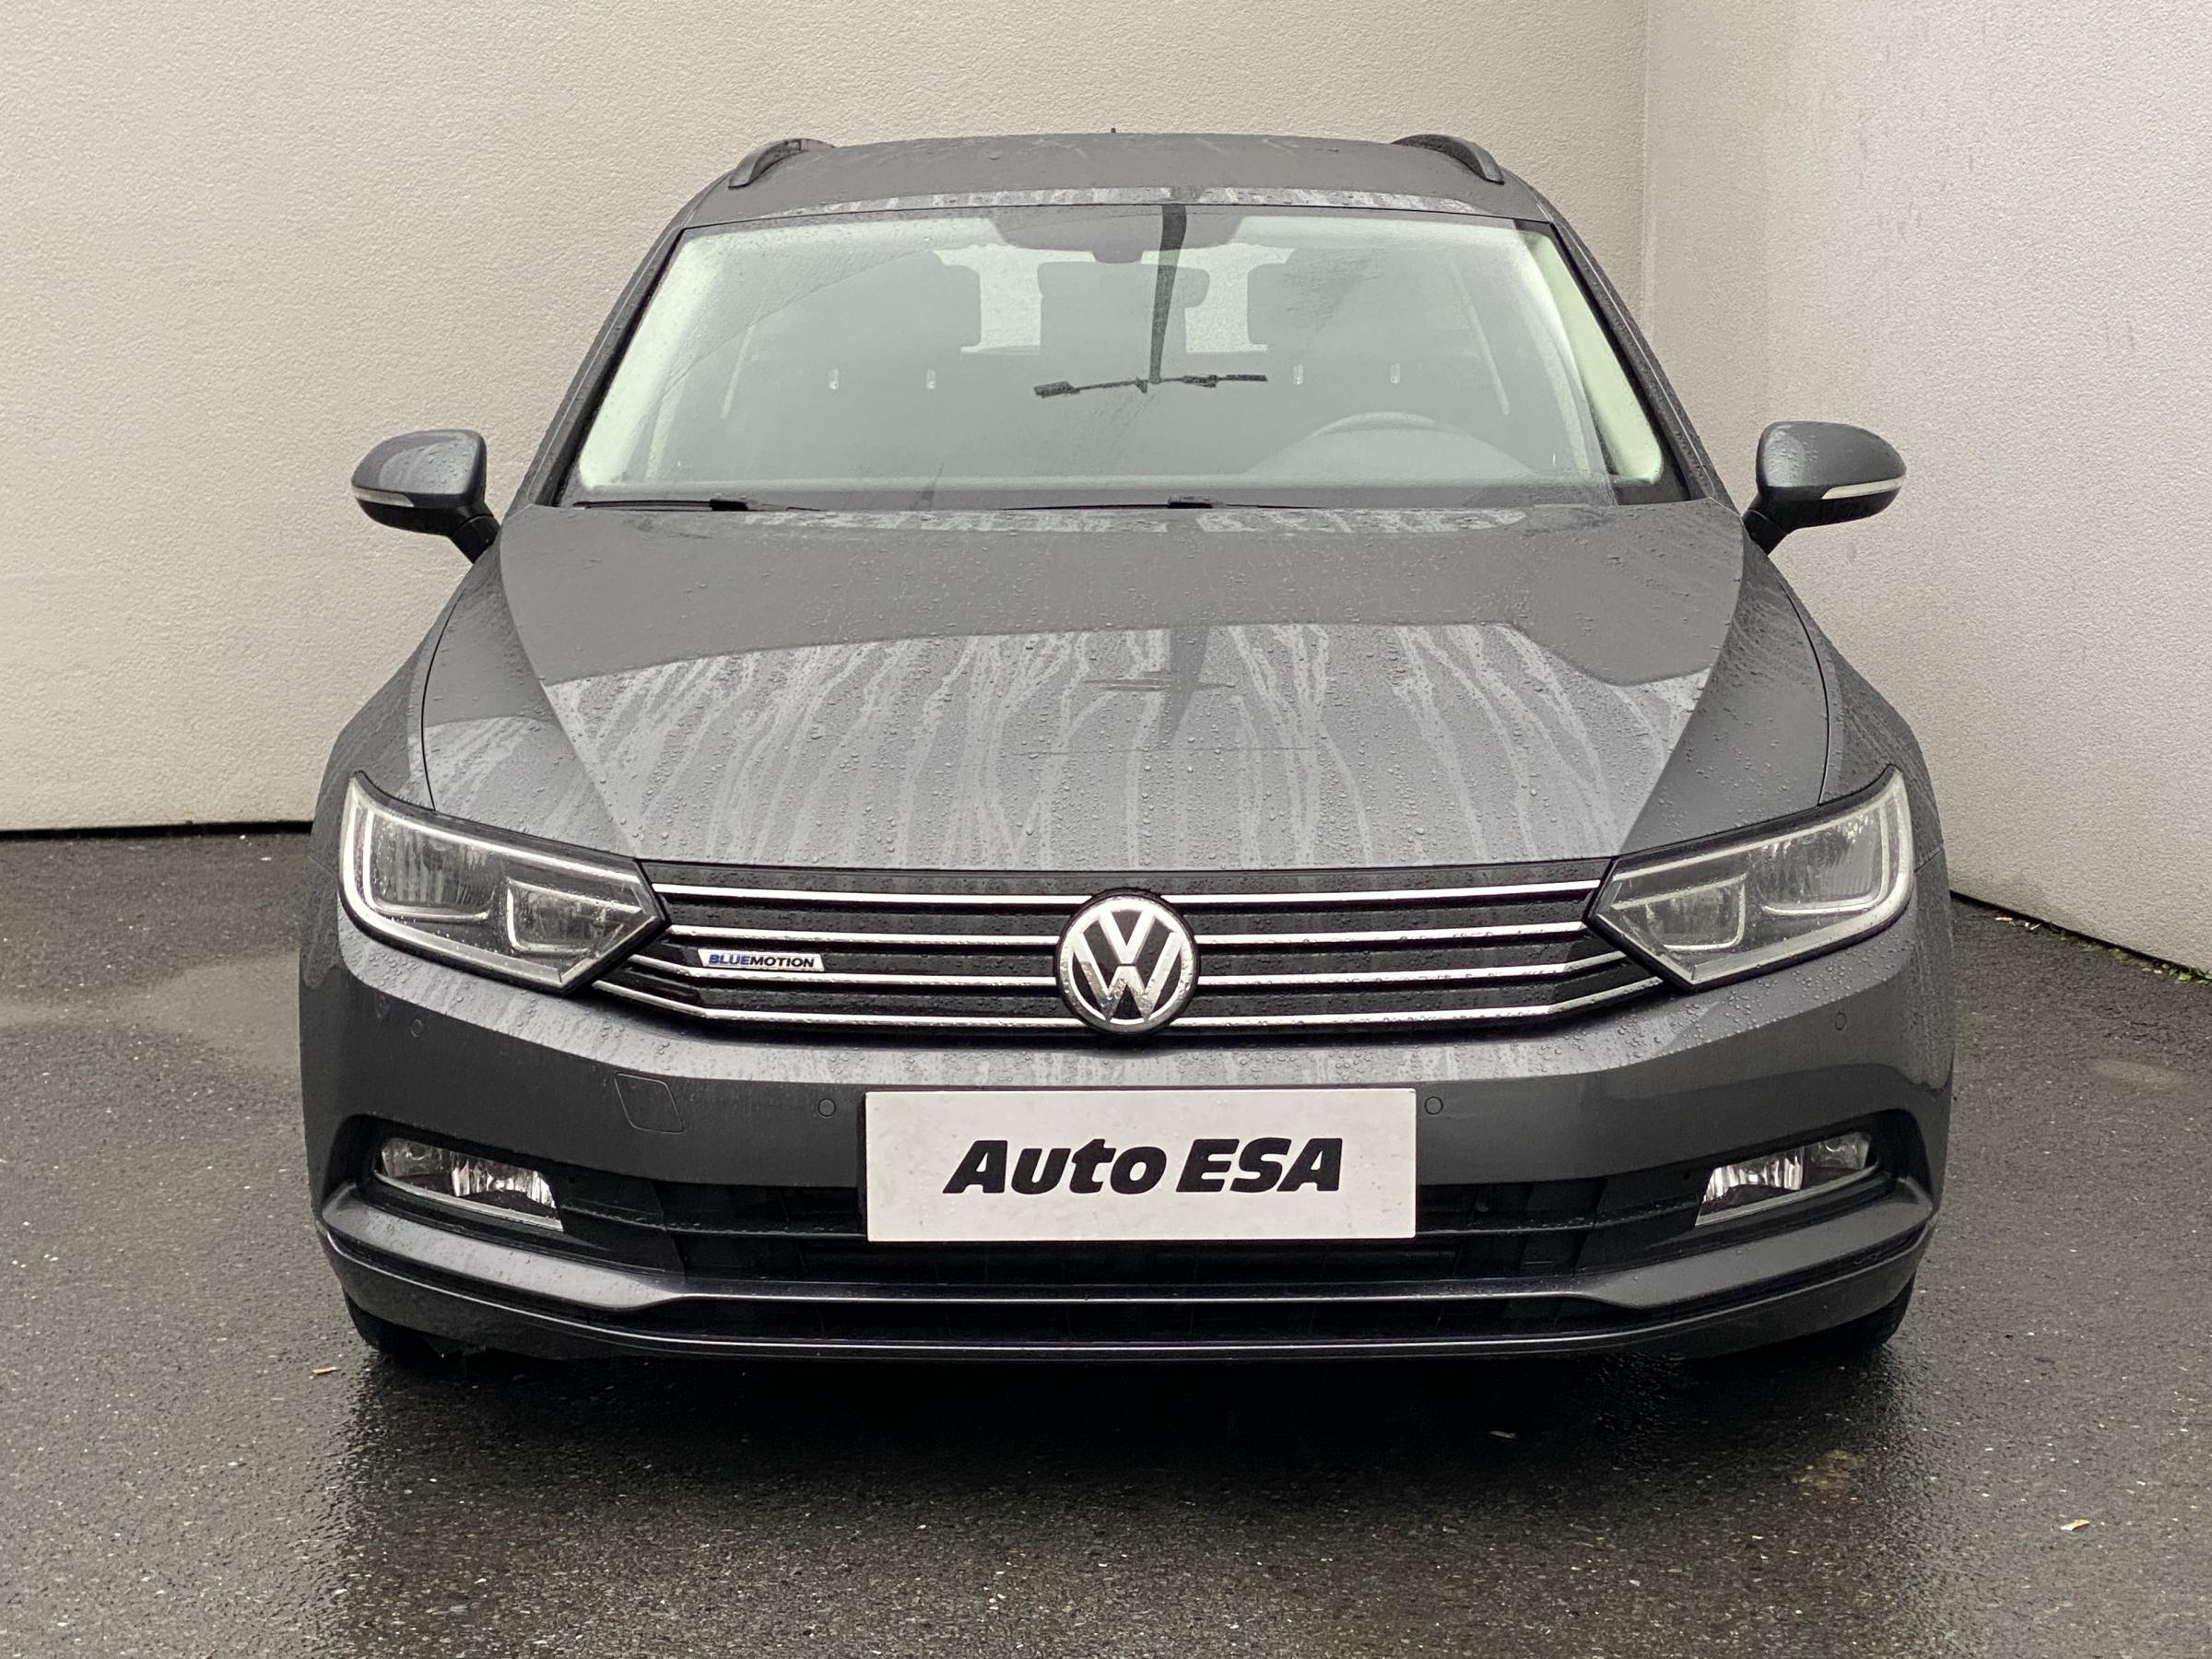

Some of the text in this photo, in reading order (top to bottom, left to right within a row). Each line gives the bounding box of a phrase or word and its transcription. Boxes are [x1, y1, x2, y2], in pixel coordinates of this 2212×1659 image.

[709, 954, 814, 967] BLUEMOTION
[1062, 898, 1192, 1030] VW
[942, 1137, 1343, 1194] Auto ESA
